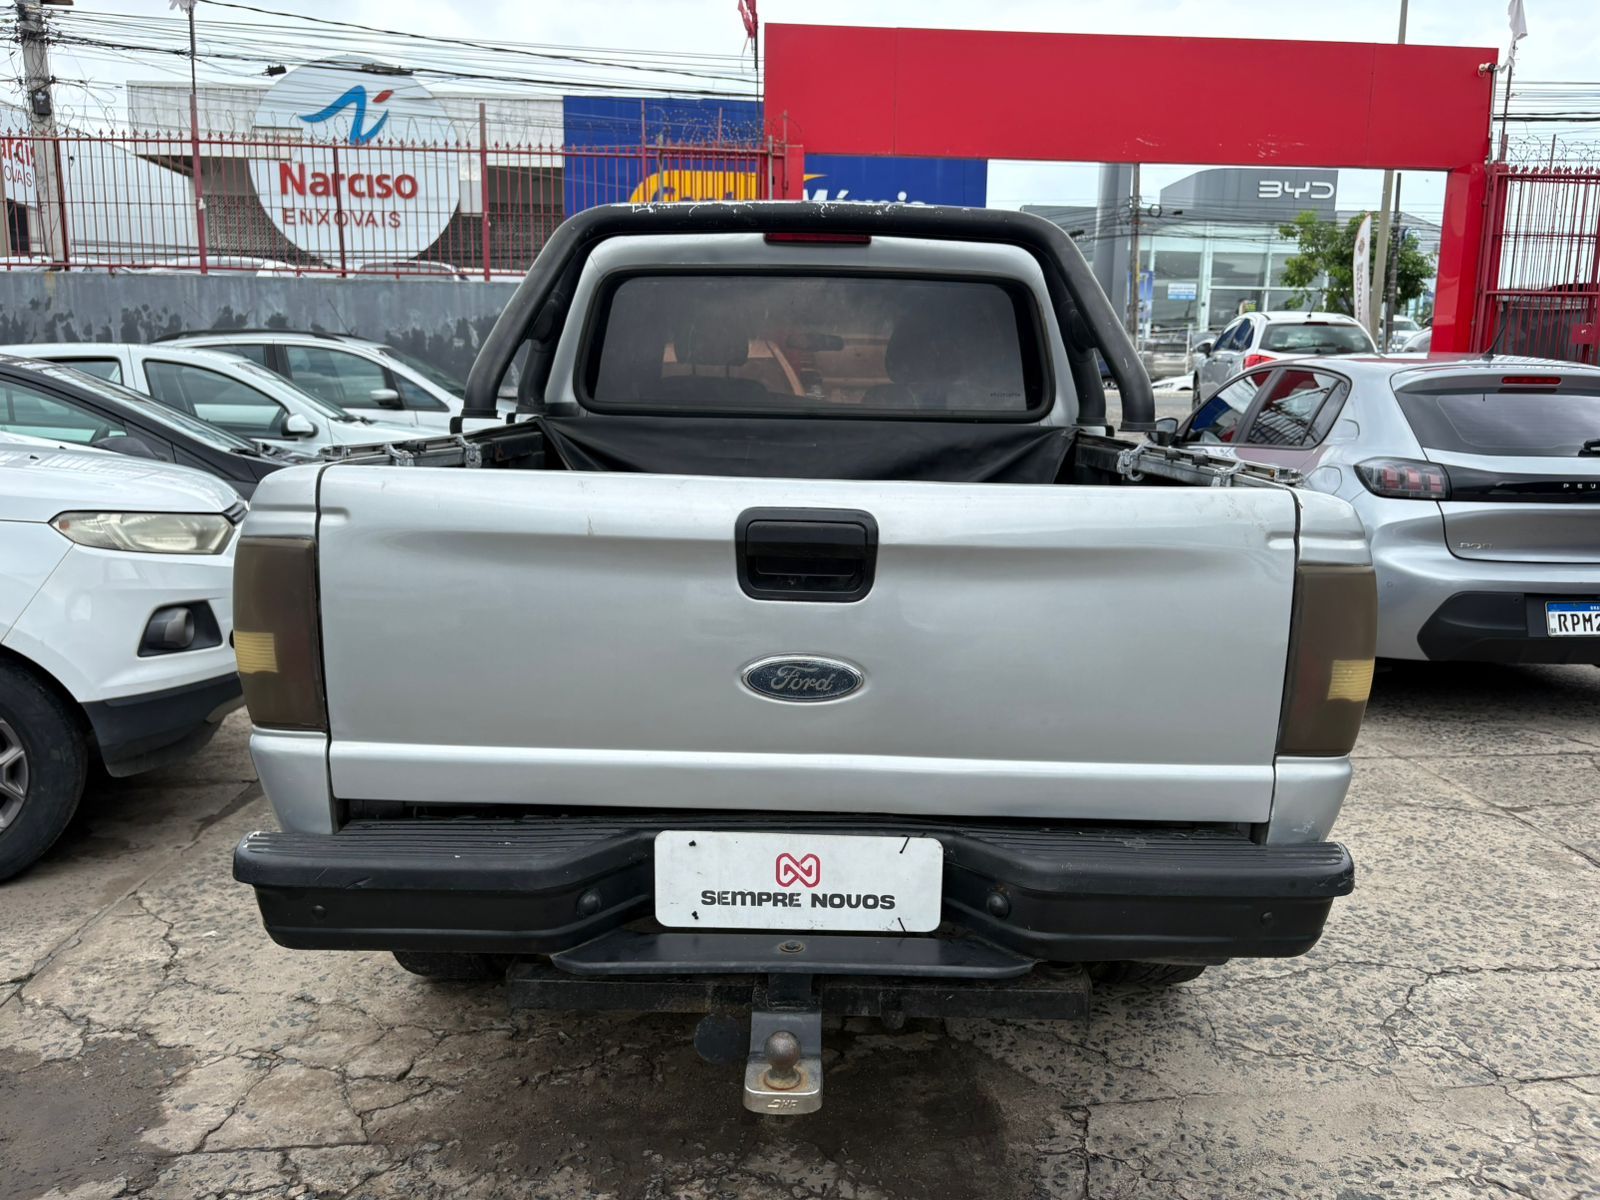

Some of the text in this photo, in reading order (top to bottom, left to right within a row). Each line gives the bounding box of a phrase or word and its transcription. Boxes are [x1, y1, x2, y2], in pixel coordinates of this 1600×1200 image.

[279, 162, 419, 200] Narciso
[1258, 180, 1335, 199] BYD
[283, 207, 402, 229] ENXOVAIS
[770, 665, 836, 690] Ford
[810, 893, 896, 910] NOVOS
